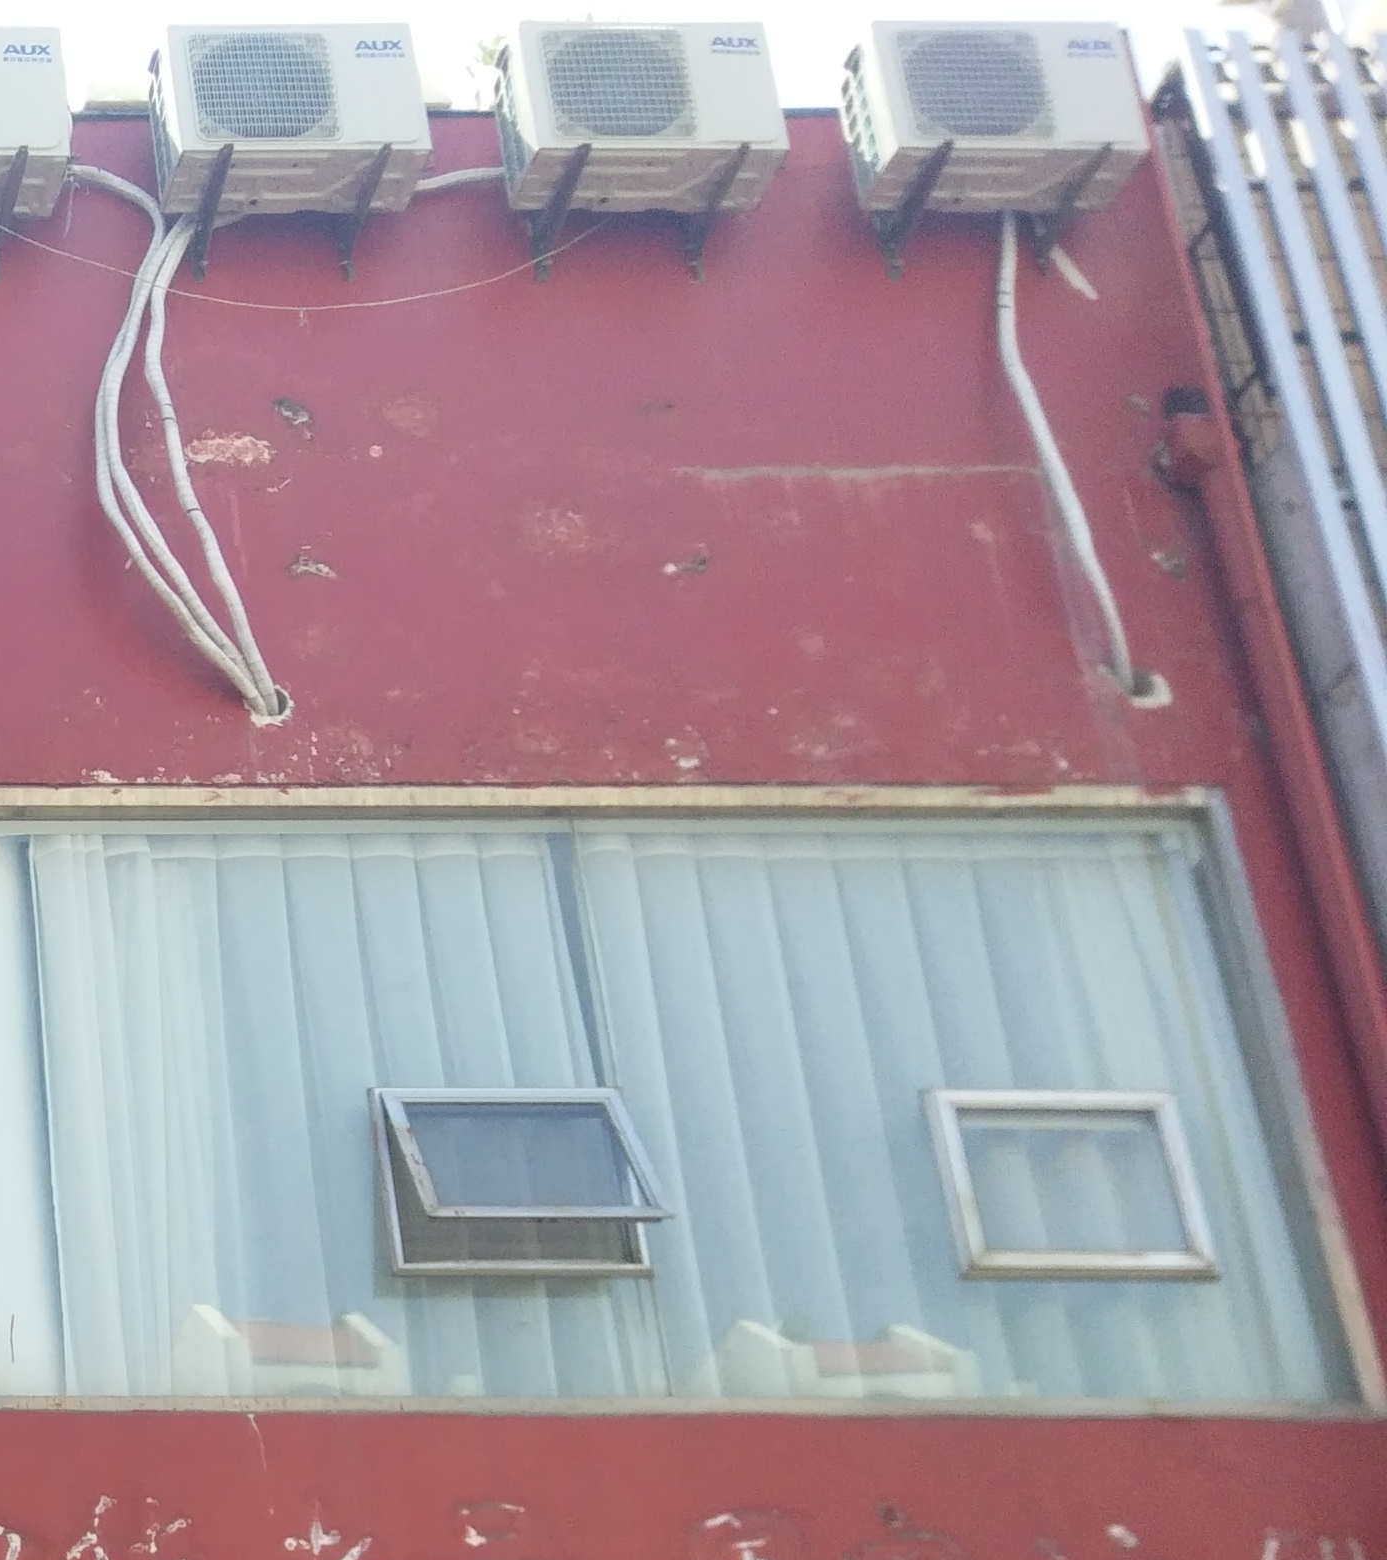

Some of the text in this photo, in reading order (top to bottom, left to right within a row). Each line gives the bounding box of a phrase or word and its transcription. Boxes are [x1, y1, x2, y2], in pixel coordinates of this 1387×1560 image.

[355, 40, 402, 51] AUX
[711, 36, 758, 48] AUX
[3, 44, 51, 55] AUX
